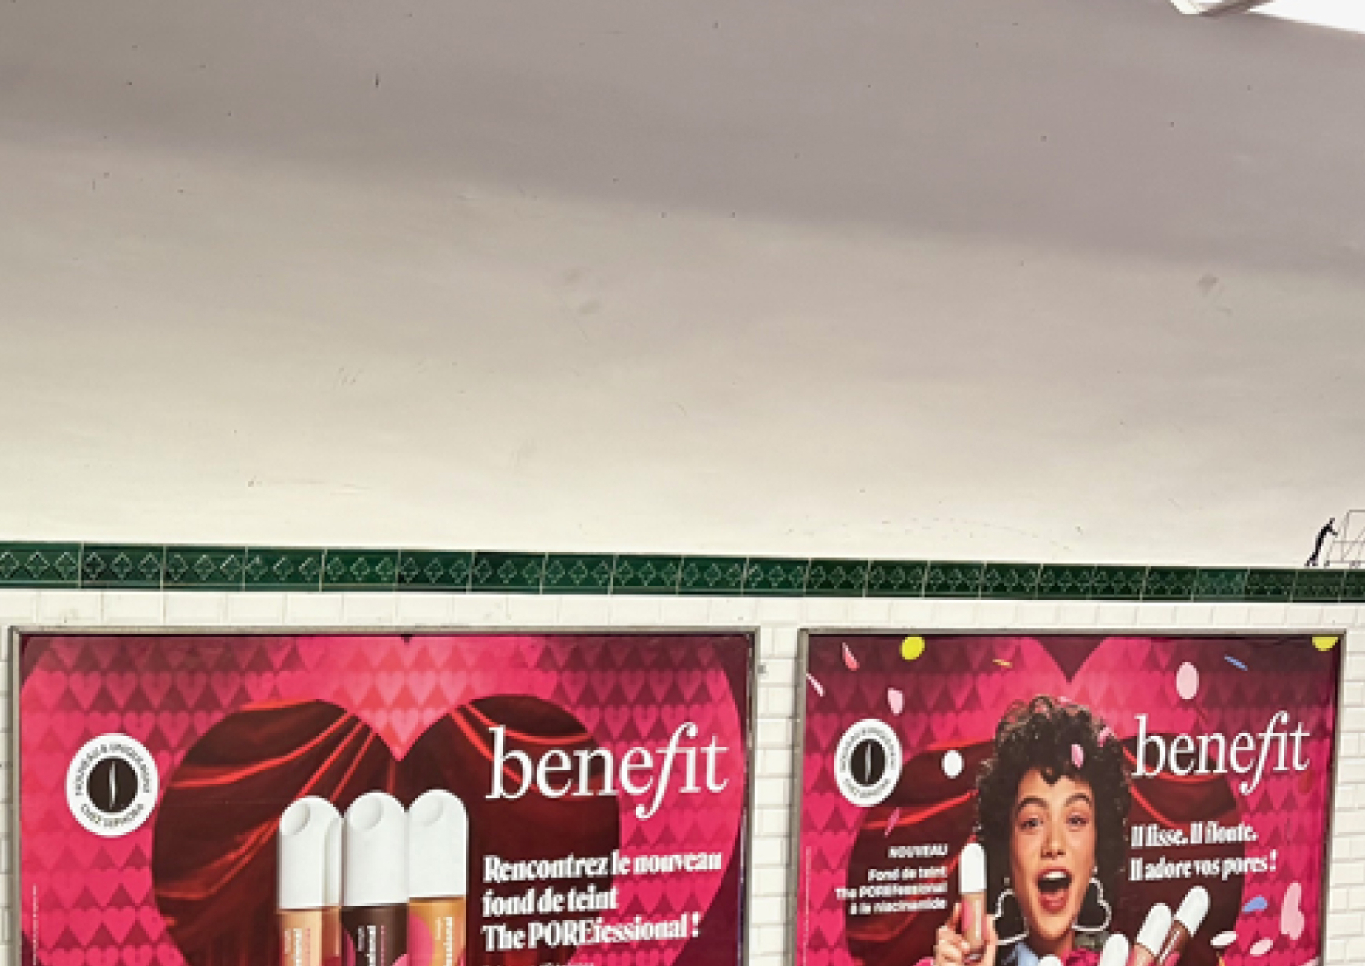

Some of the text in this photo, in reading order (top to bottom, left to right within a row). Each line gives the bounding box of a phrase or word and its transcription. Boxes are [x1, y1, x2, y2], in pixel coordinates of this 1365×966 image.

[486, 722, 729, 820] benefit
[1131, 710, 1309, 796] benefit
[483, 849, 722, 883] Rencontrez le nouveau
[1145, 855, 1191, 880] adore
[1193, 859, 1219, 877] vos
[482, 883, 619, 917] fond de teint
[480, 923, 526, 951] The
[527, 912, 688, 948] POREfessional
